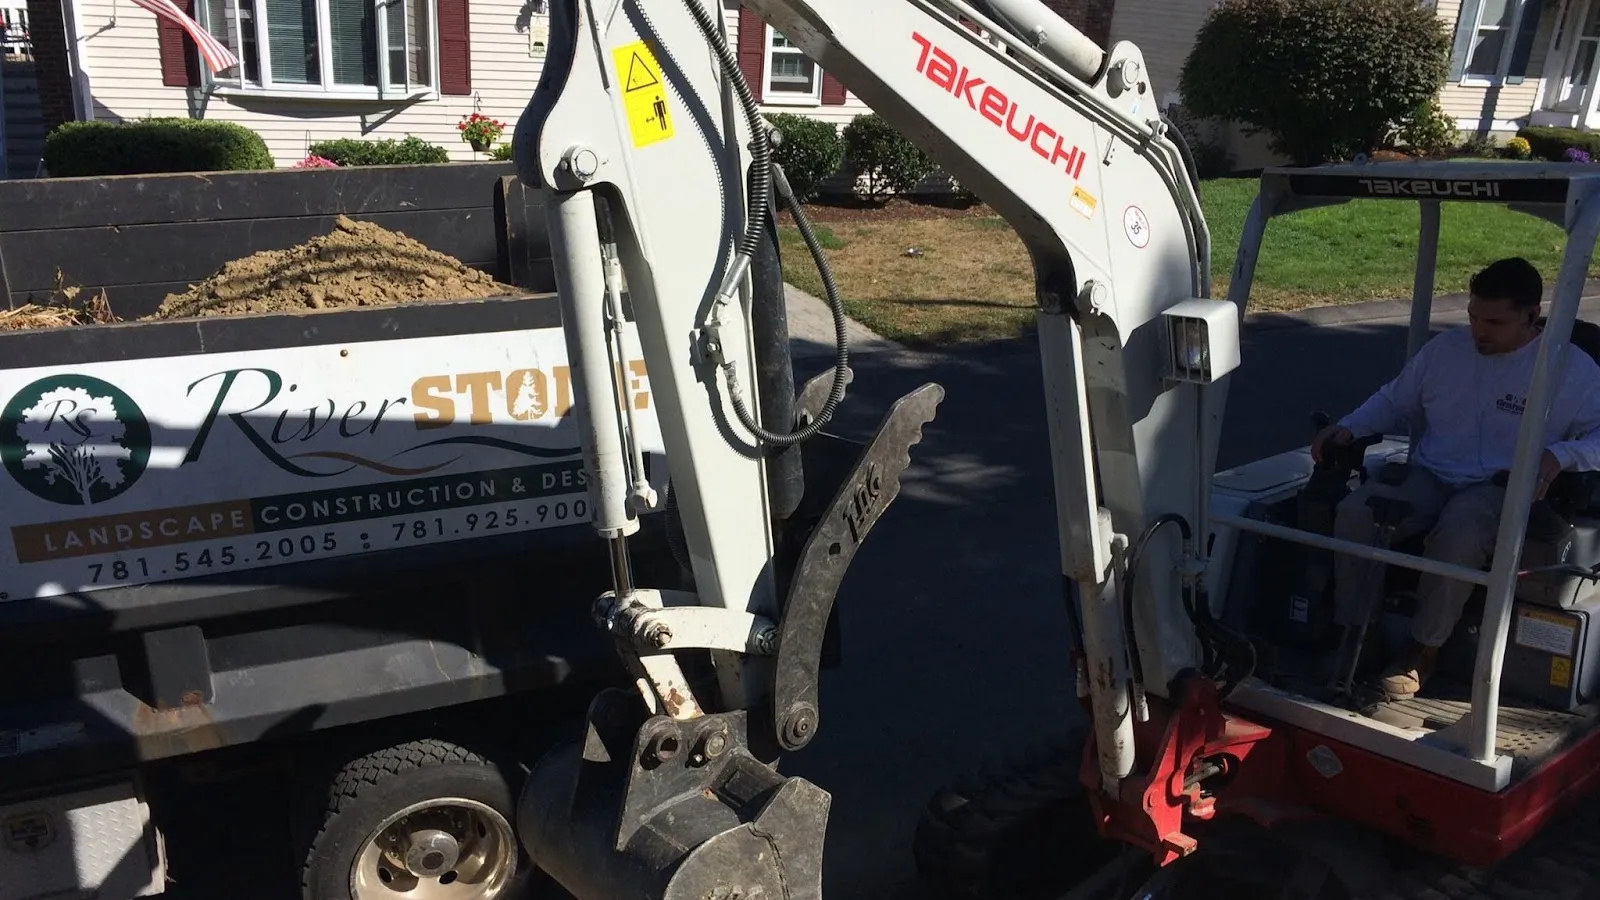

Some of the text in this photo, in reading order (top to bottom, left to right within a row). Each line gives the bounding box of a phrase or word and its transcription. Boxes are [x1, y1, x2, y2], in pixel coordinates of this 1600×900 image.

[1130, 221, 1142, 235] 35
[179, 359, 650, 478] River STOE
[44, 467, 588, 551] LANDSCAPE CONSTRUCTION & DES
[391, 499, 588, 541] 781.925.900
[87, 531, 338, 584] 781.545.2005
